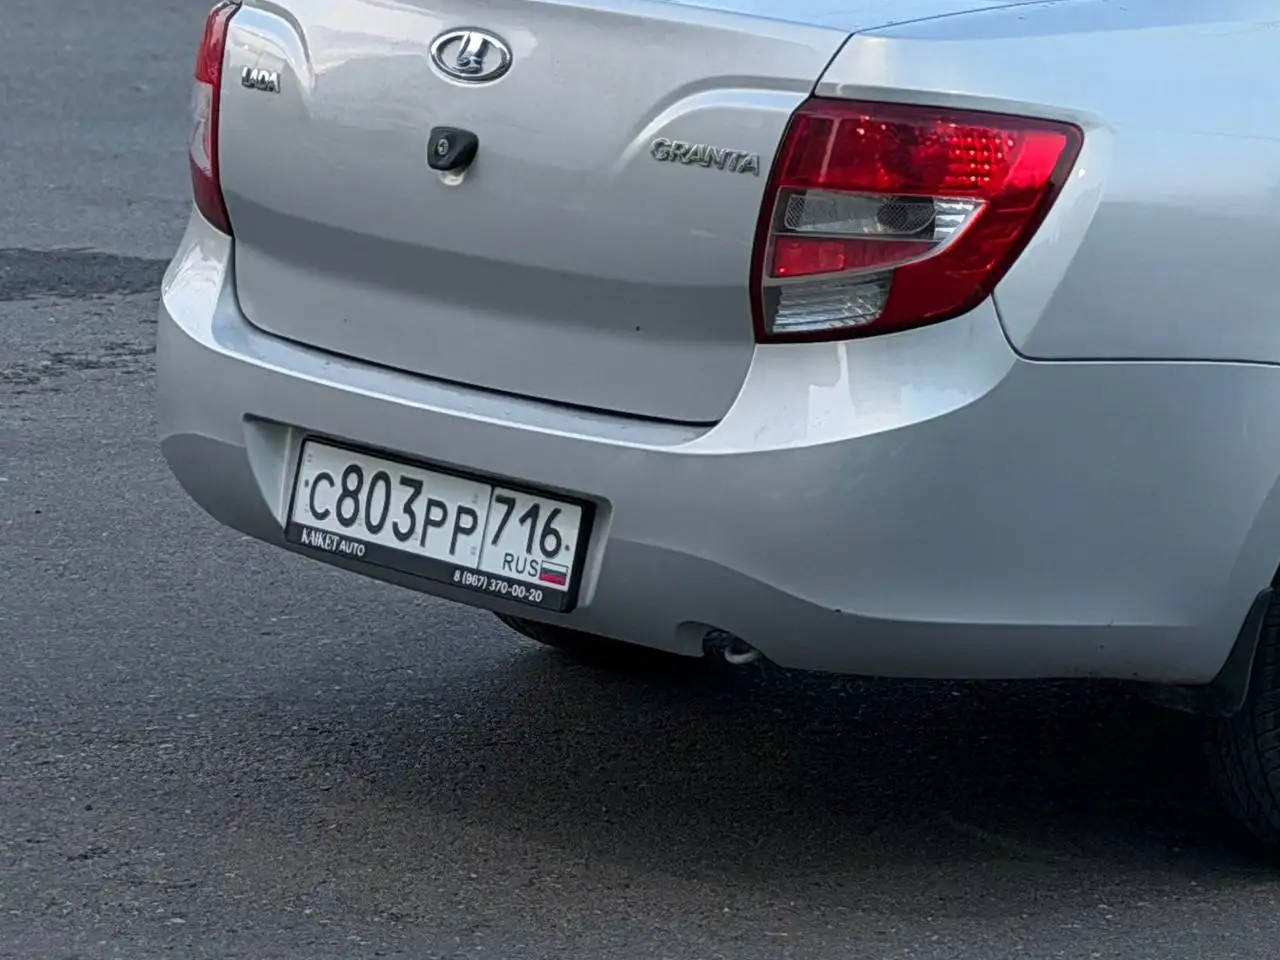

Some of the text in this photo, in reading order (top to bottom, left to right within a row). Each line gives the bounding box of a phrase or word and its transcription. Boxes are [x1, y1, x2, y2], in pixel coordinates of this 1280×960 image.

[241, 65, 281, 94] LADA
[650, 137, 760, 177] GRANTA
[491, 493, 562, 559] 716
[339, 540, 367, 557] AUTO
[502, 552, 540, 578] RUS
[453, 569, 462, 582] 8
[488, 578, 544, 602] 370-00-20
